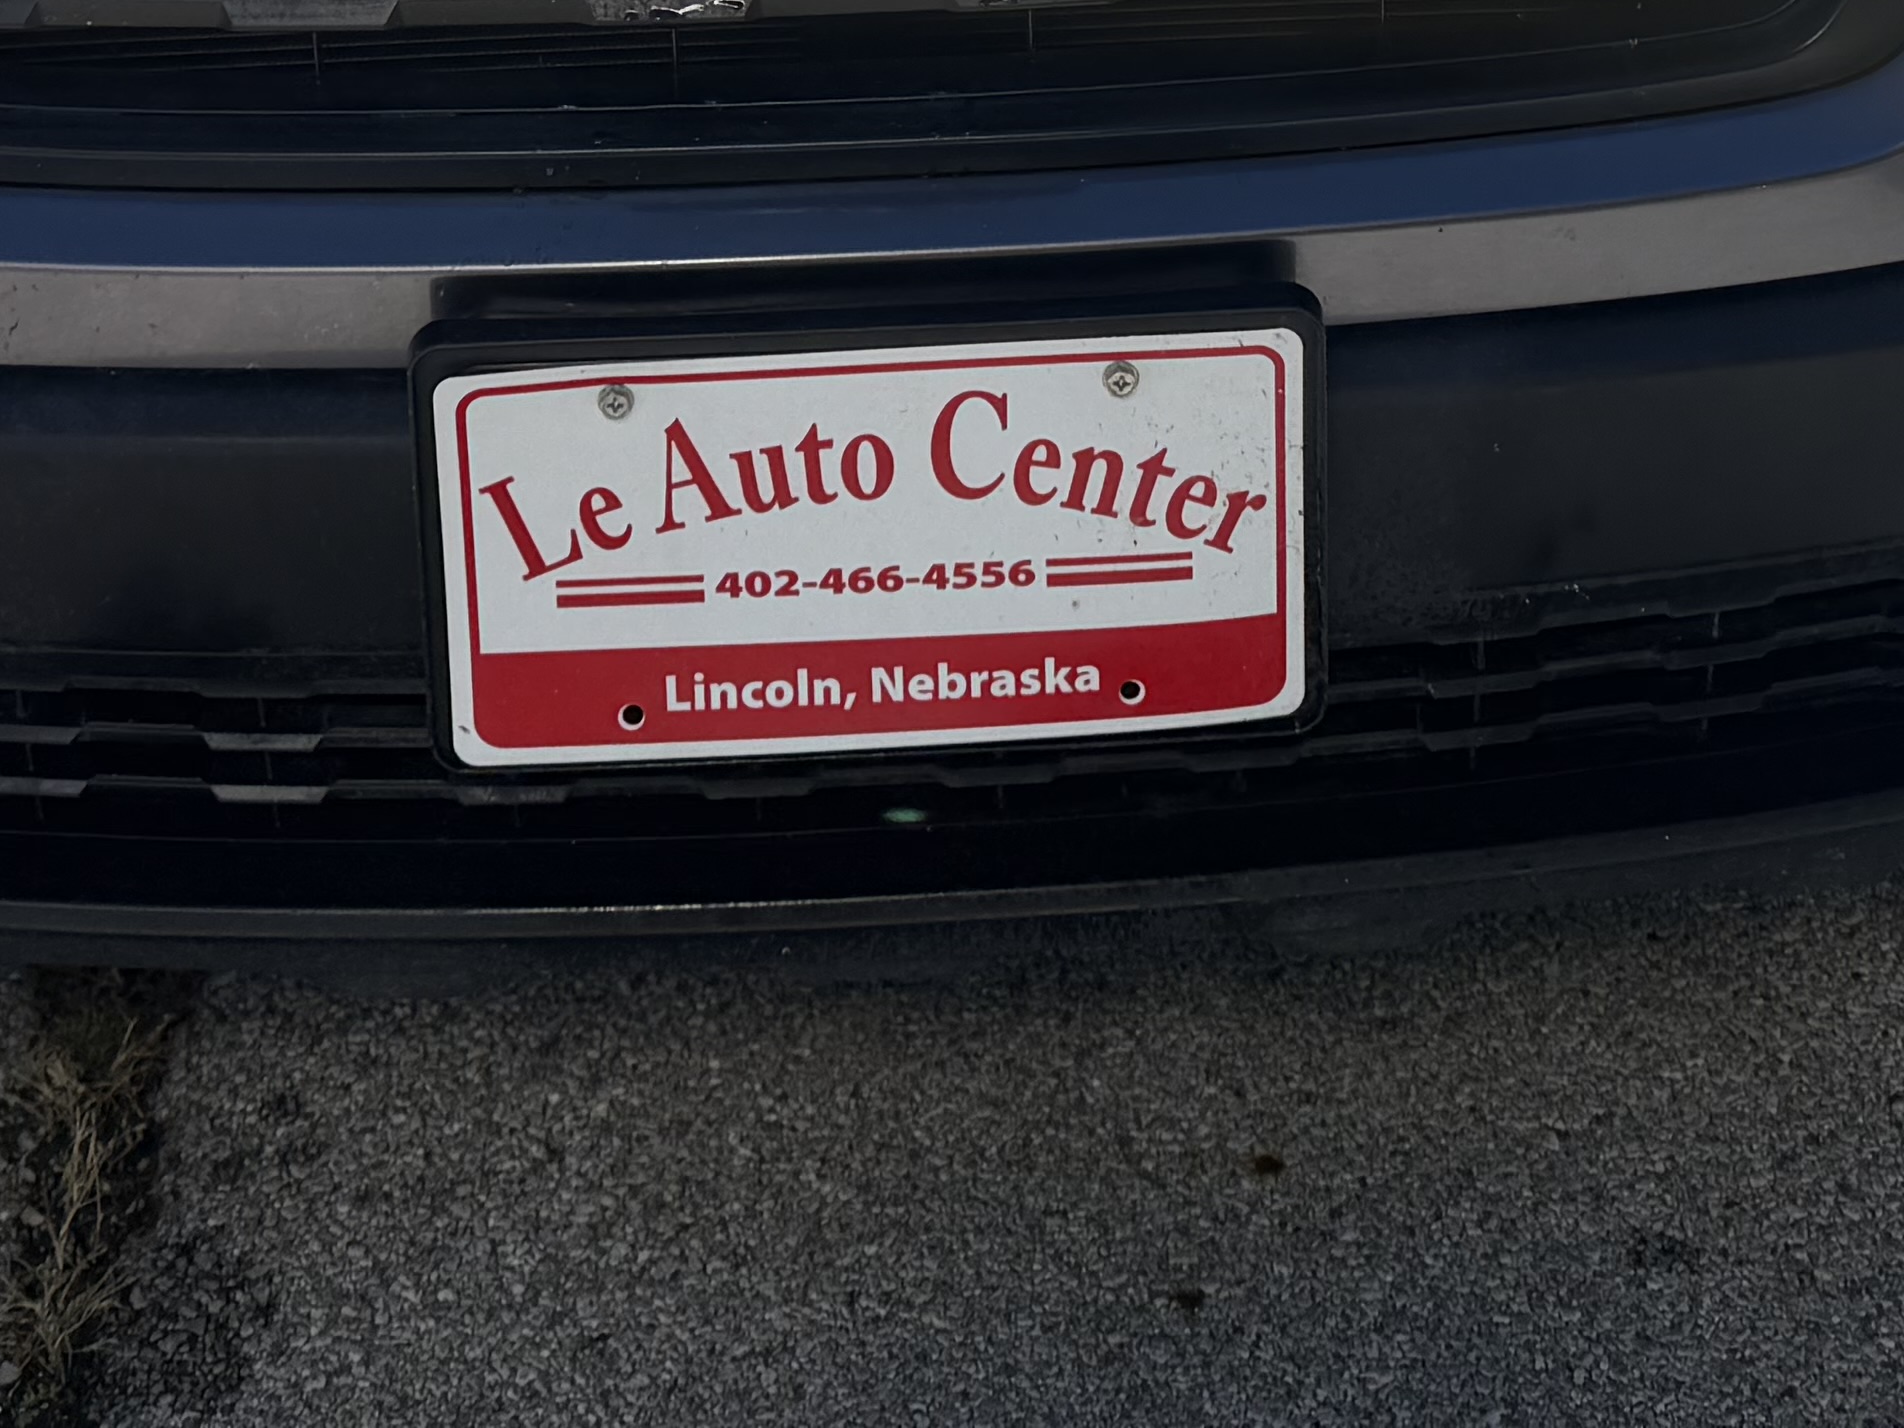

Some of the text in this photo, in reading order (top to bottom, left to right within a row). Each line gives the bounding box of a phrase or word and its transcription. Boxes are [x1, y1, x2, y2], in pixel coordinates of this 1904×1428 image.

[479, 389, 1267, 582] Le Auto Center
[714, 558, 1038, 601] 402-466-4556
[664, 657, 1102, 712] Lincoln, Nebraska
